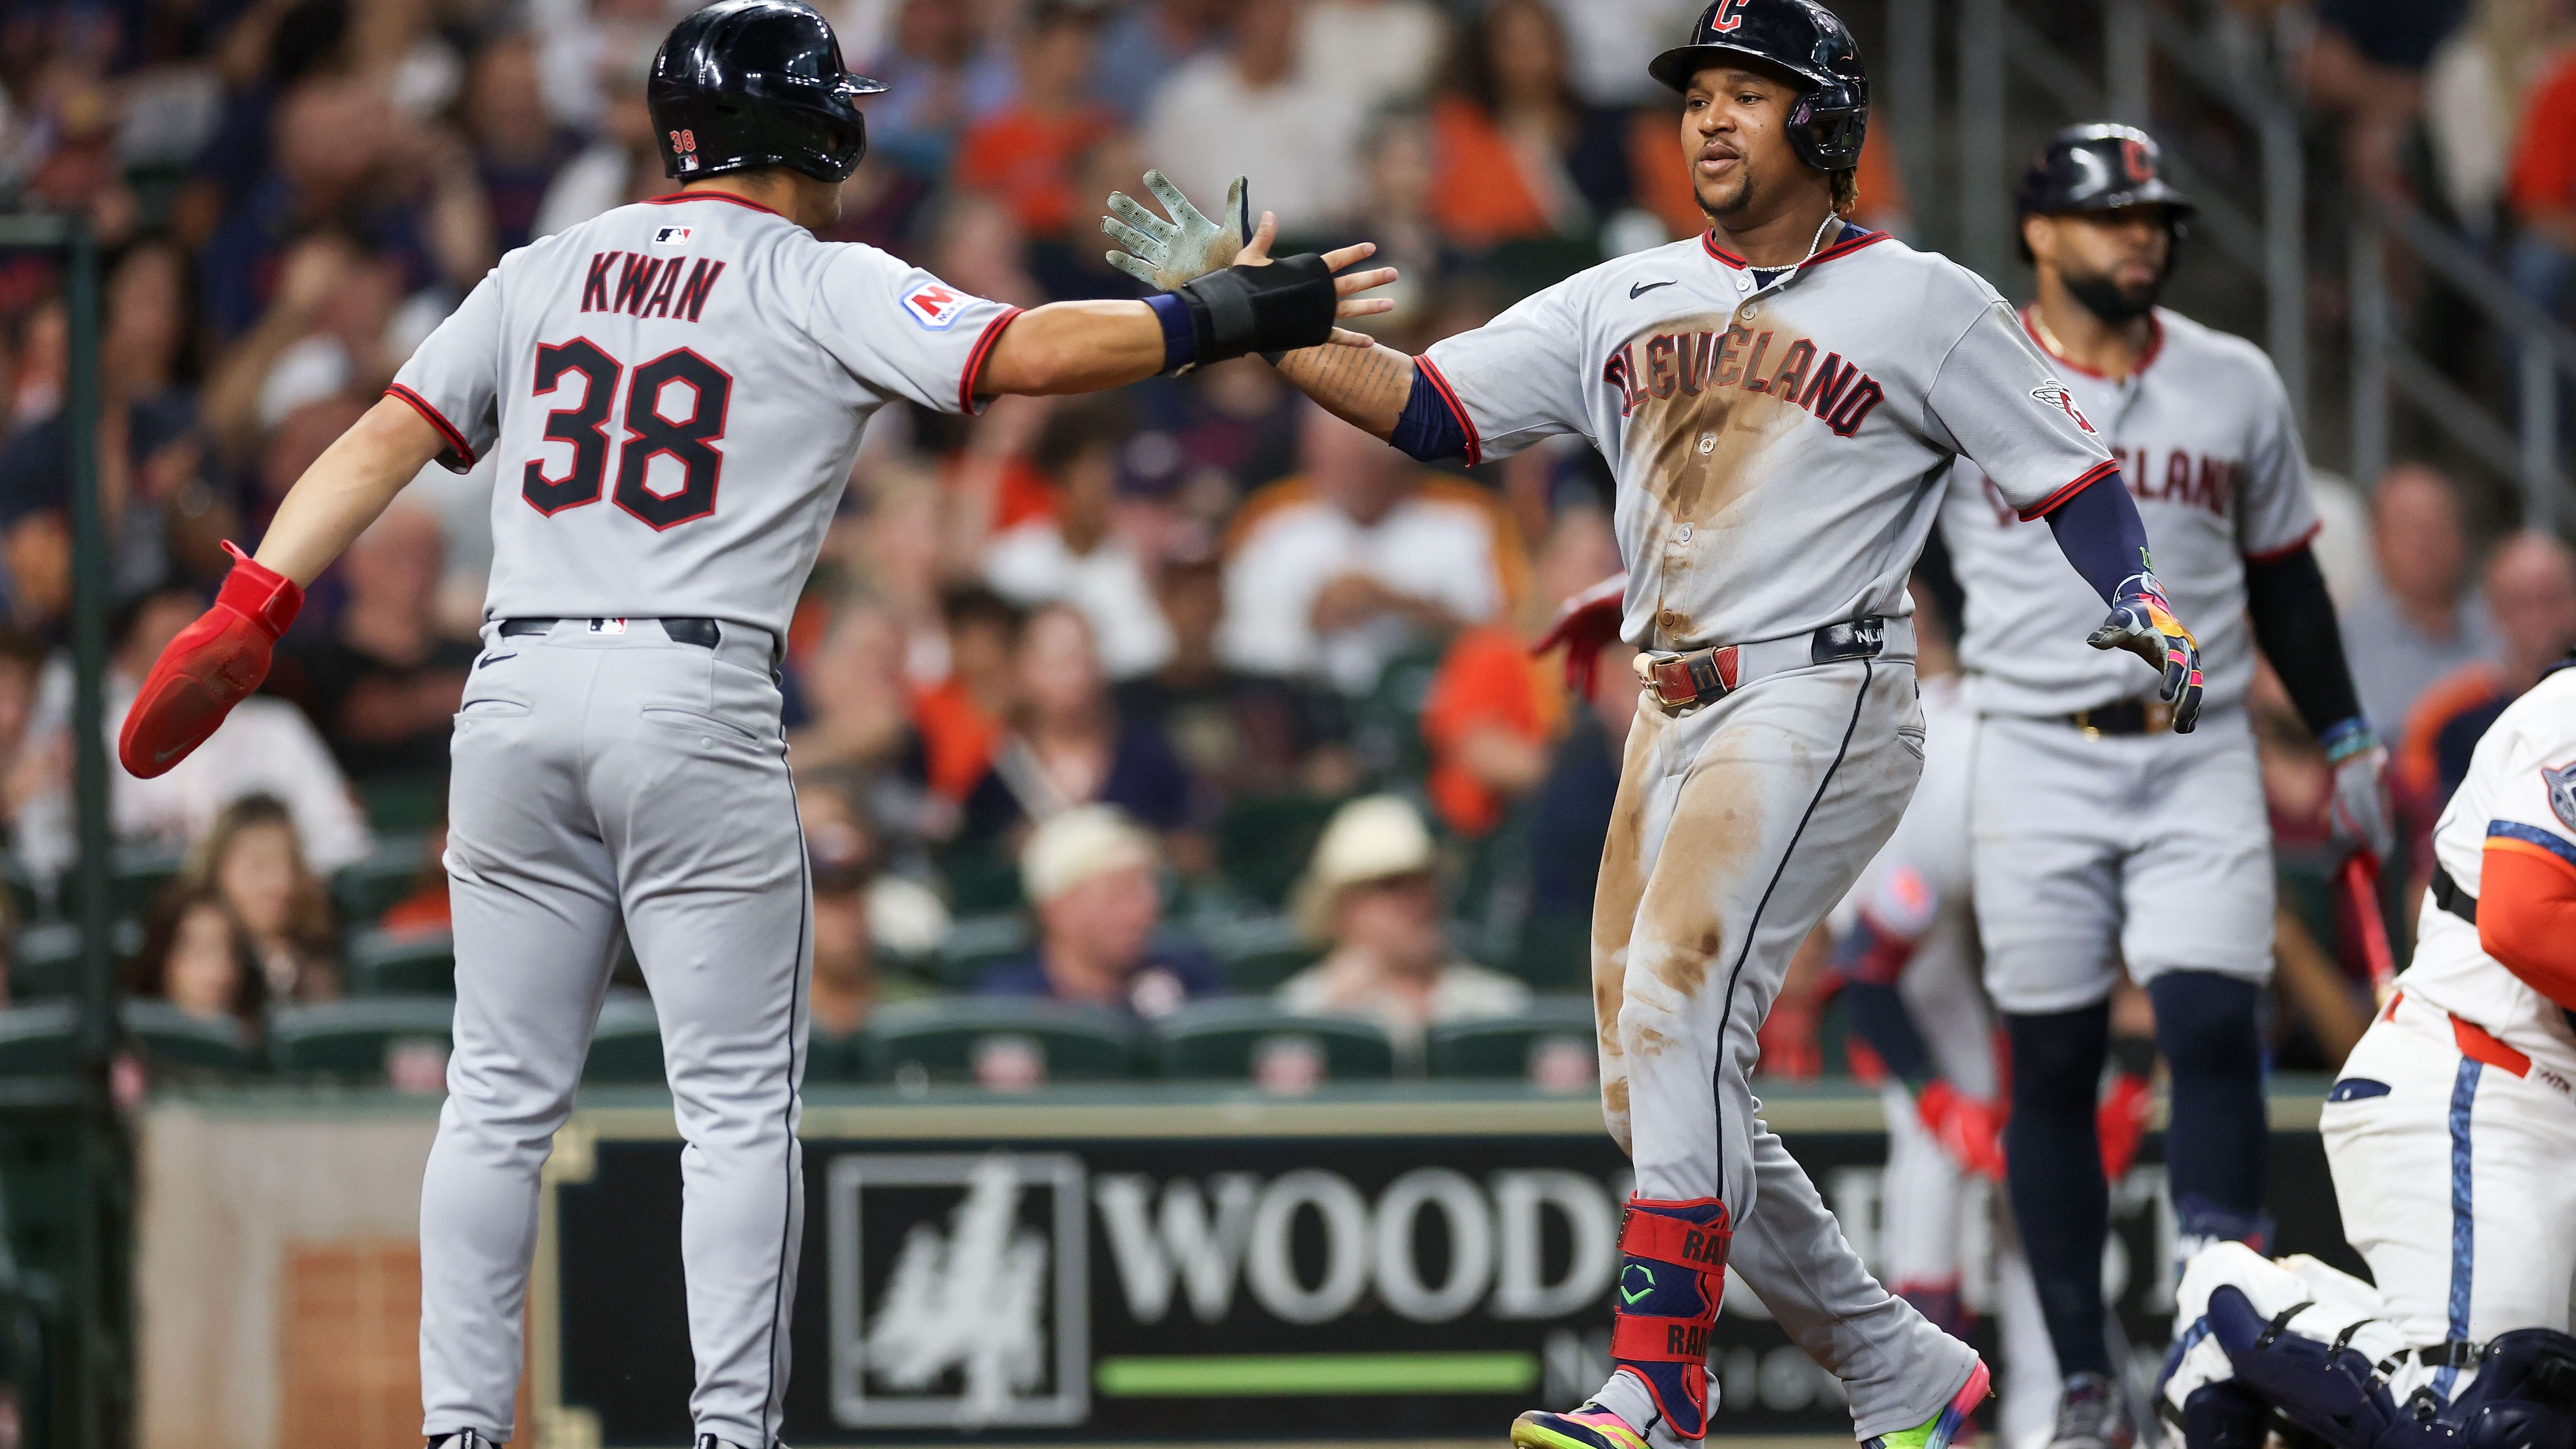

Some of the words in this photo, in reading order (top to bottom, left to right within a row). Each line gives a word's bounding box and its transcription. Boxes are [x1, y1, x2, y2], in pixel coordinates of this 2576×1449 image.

[1711, 0, 1750, 33] C
[670, 129, 696, 153] 38
[580, 251, 726, 322] KWAN
[1604, 321, 1884, 438] CLEVELAND
[522, 336, 733, 532] 38
